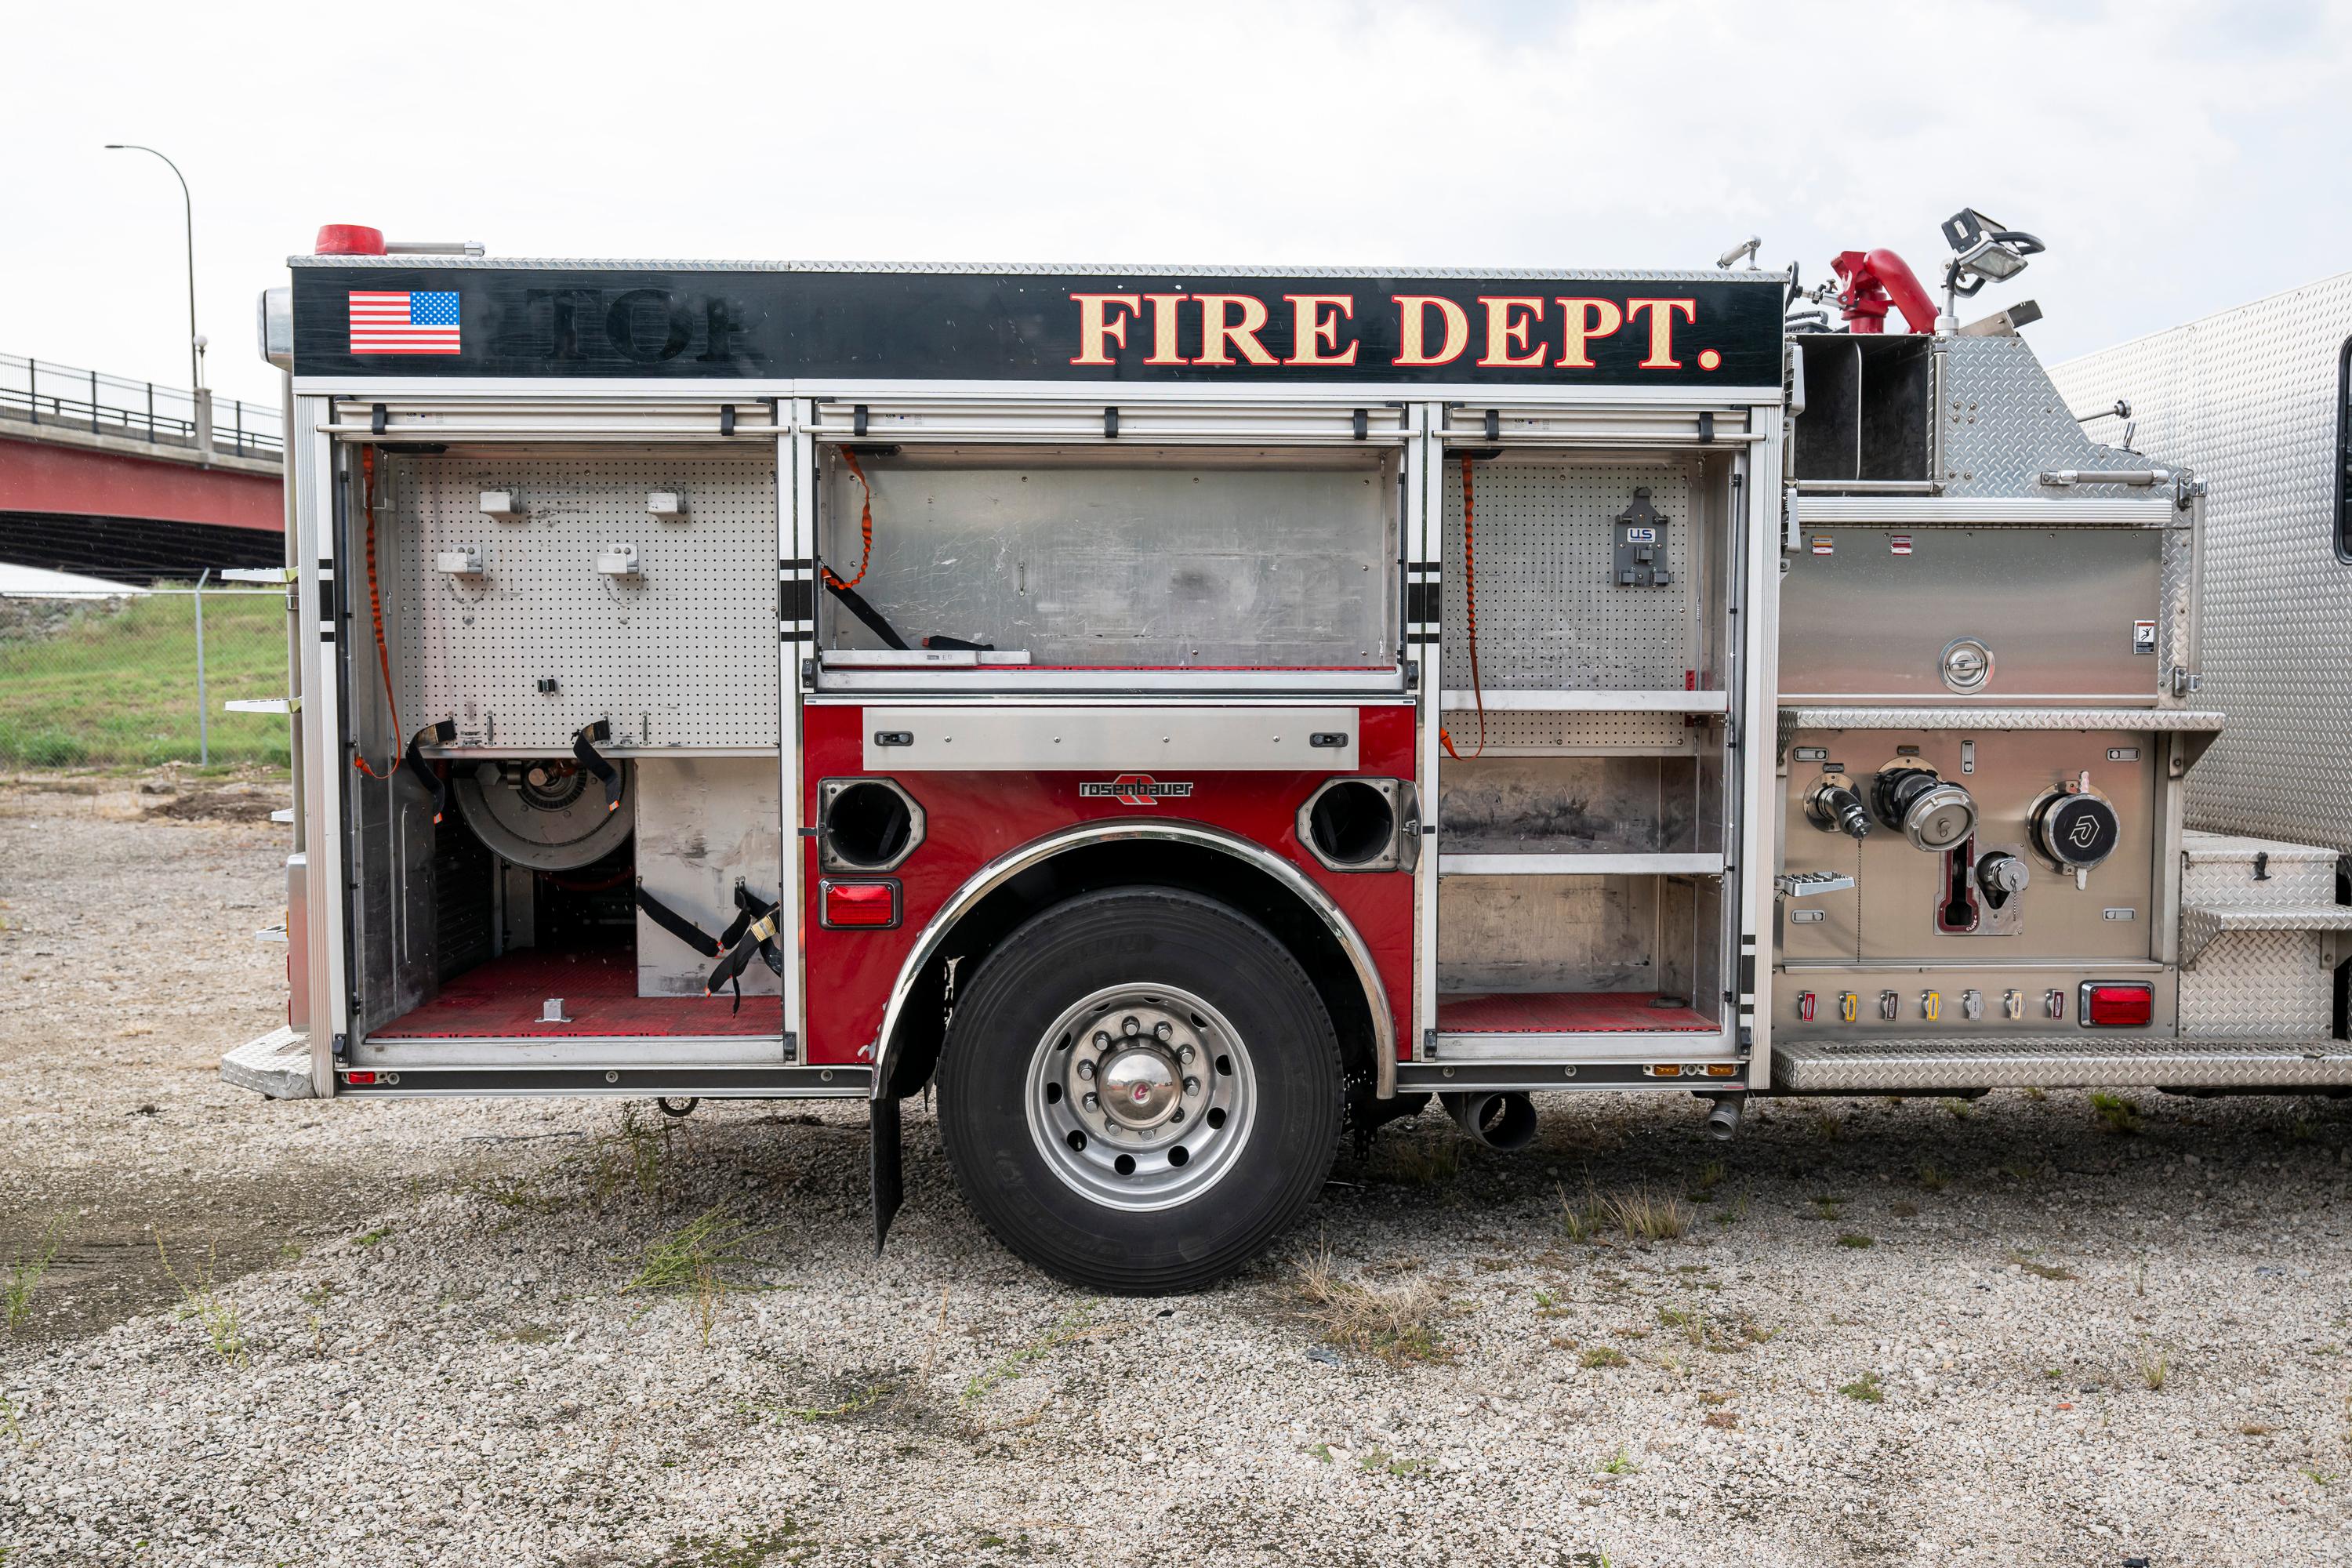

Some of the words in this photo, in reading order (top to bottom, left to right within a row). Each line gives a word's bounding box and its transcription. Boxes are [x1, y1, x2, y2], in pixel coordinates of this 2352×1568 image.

[1069, 293, 1359, 366] FIRE
[1392, 295, 1722, 371] DEPT.
[1080, 777, 1193, 797] rosenbauer
